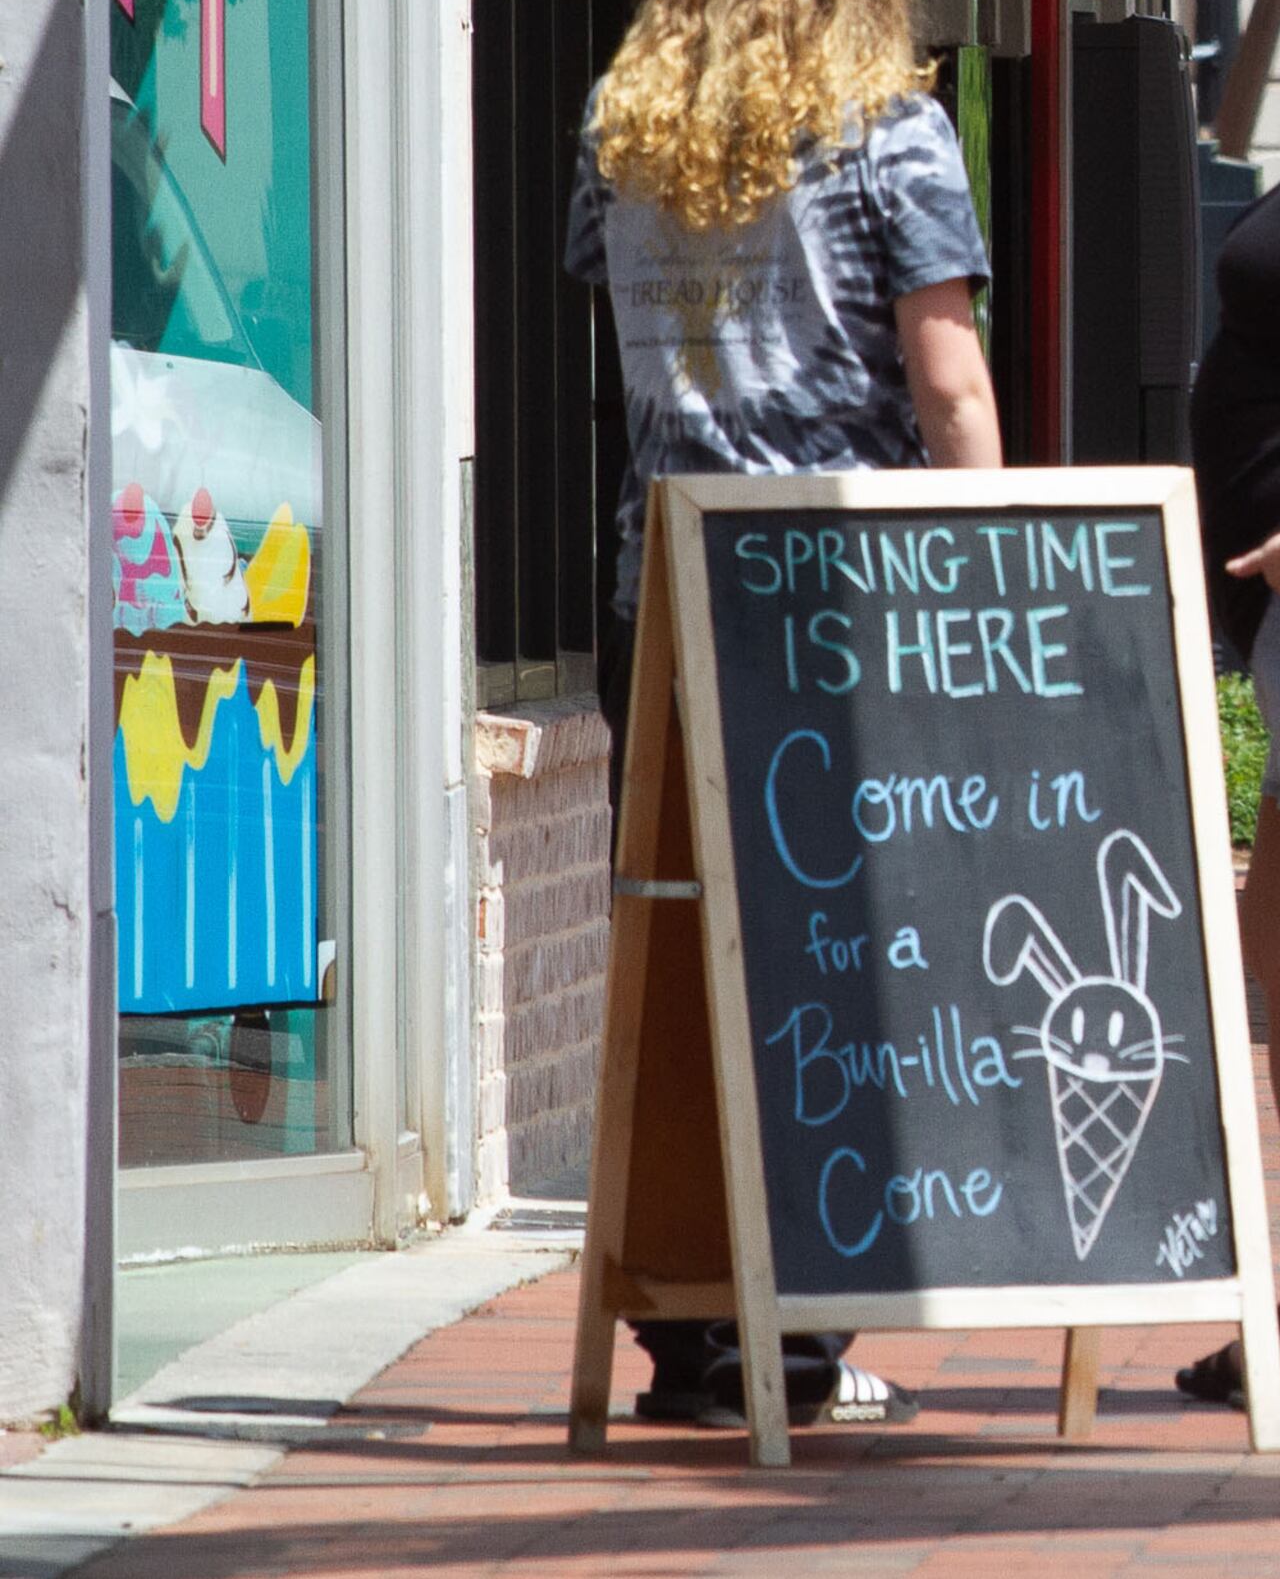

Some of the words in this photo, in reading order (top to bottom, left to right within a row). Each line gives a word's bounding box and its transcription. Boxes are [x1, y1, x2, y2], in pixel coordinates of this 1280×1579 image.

[785, 608, 862, 695] IS
[885, 604, 1085, 699] HERE
[765, 729, 999, 889] Come
[1029, 769, 1103, 832] in
[804, 911, 869, 975] for
[887, 925, 929, 971] a
[764, 1001, 1023, 1126] Bun-illa
[818, 1145, 1003, 1258] Cone
